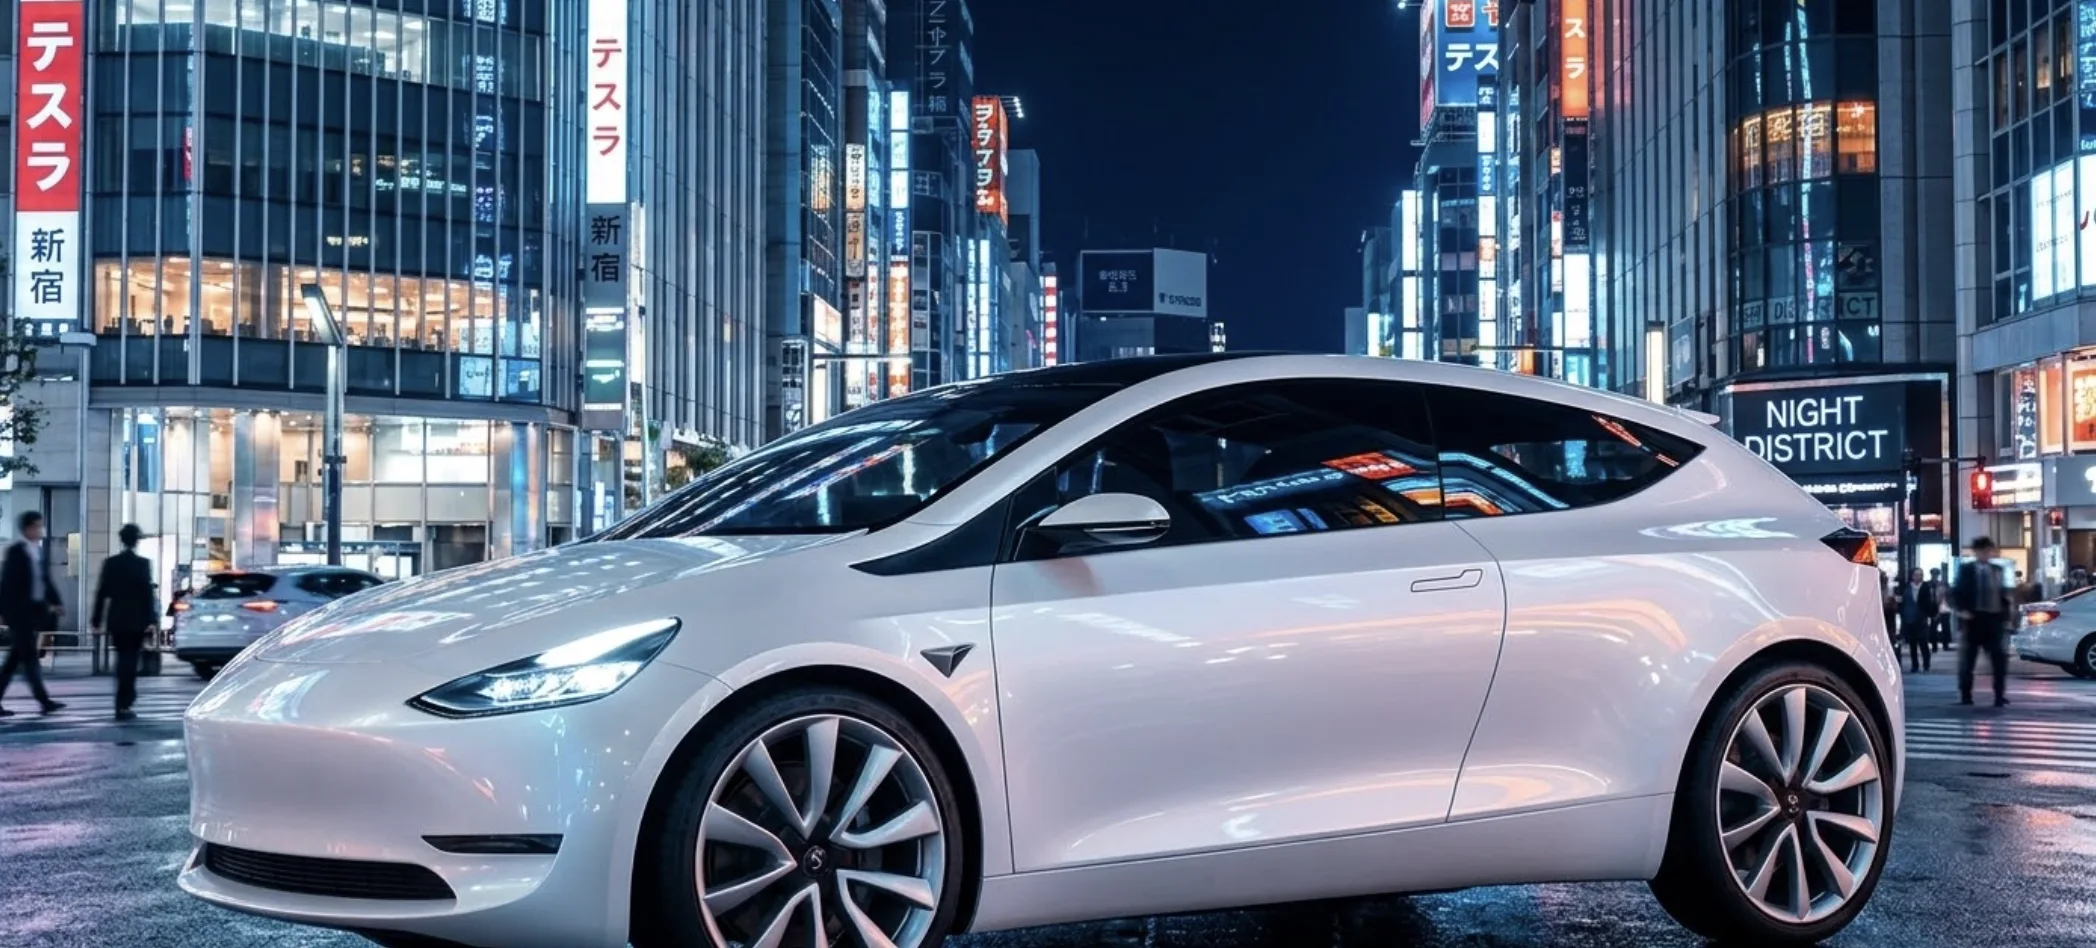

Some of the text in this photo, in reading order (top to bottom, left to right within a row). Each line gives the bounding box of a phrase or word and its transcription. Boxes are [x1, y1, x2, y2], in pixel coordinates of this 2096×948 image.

[1445, 43, 1499, 71] テス
[26, 21, 74, 191] テスラ
[591, 38, 623, 156] テスラ
[30, 227, 66, 304] 新宿
[590, 215, 622, 284] 新宿
[1745, 429, 1888, 462] DISTRICT
[1766, 395, 1864, 428] NIGHT
